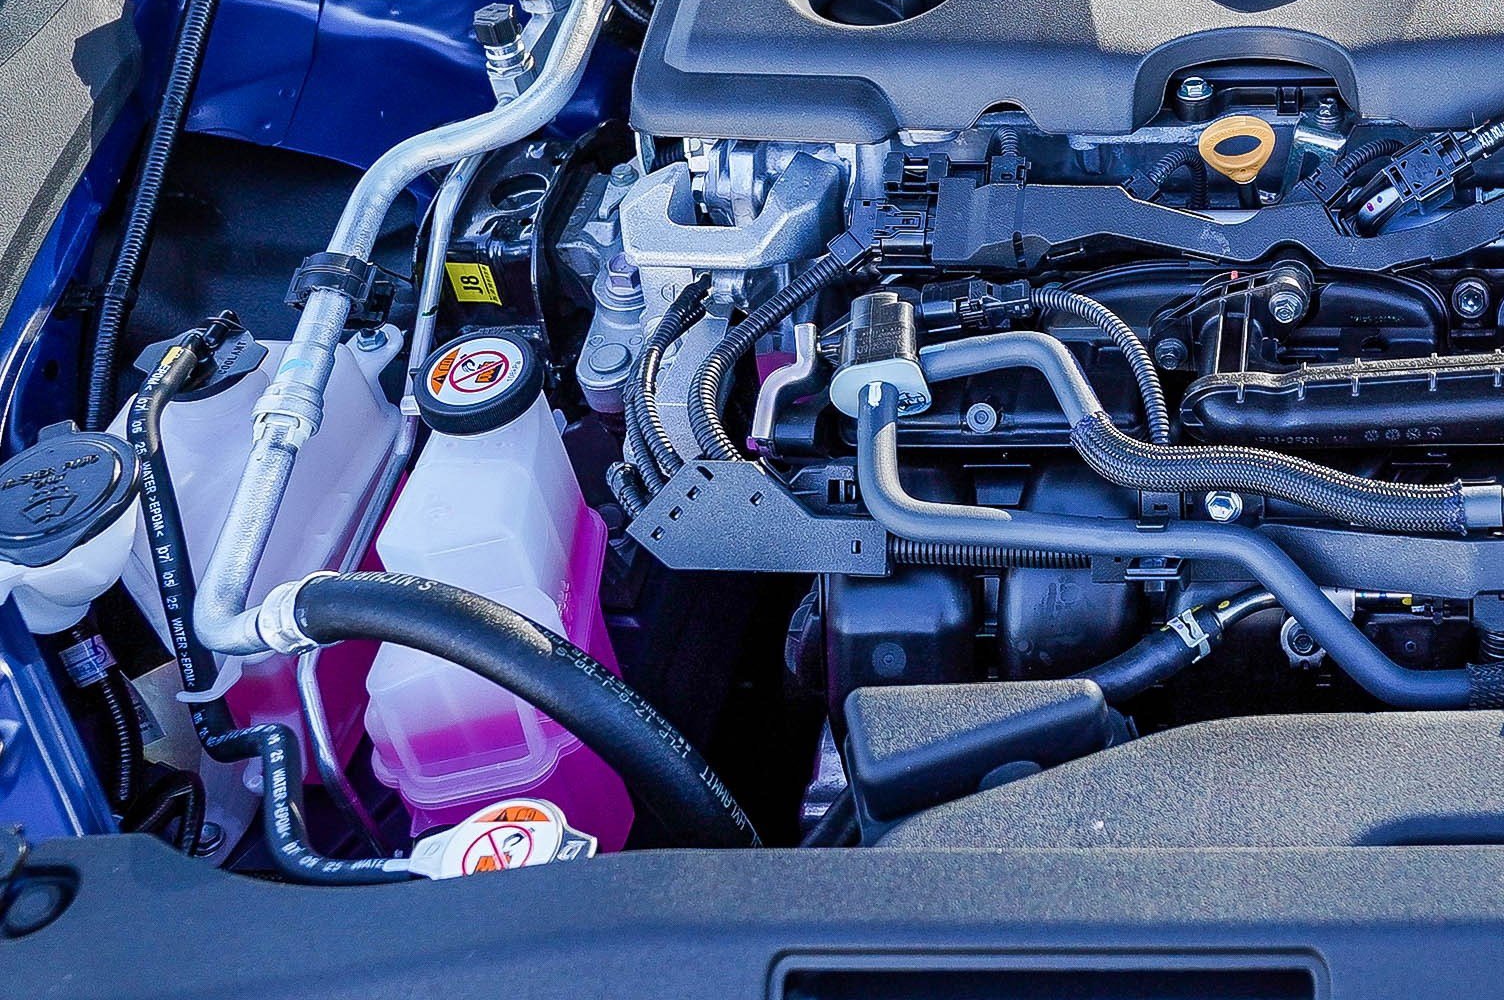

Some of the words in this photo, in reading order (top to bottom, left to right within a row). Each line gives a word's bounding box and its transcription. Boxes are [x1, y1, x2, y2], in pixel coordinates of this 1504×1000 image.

[460, 275, 484, 295] J8
[217, 340, 247, 375] COOLANT
[142, 460, 157, 496] WATER
[171, 617, 188, 649] WATER
